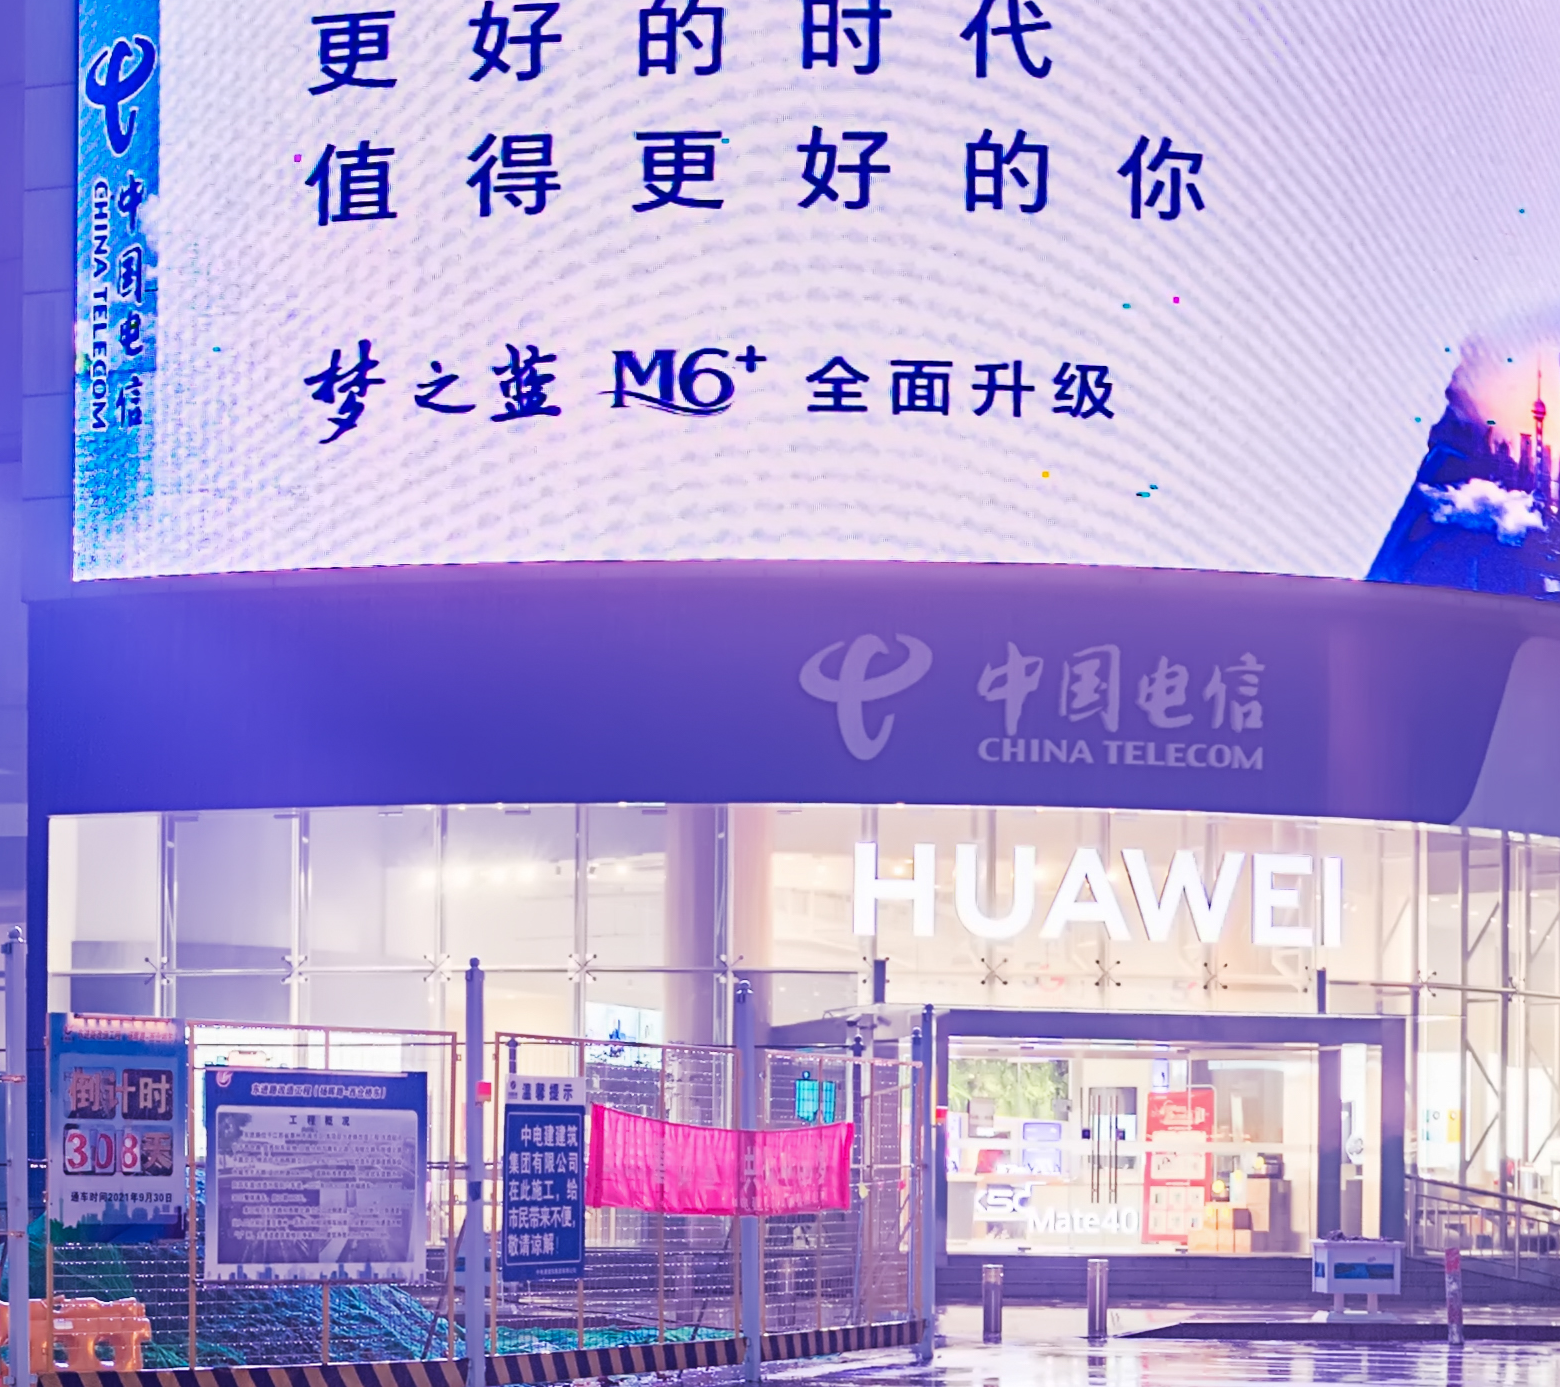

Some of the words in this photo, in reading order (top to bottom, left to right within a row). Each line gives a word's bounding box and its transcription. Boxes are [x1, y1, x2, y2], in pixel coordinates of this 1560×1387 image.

[304, 126, 1207, 228] 值得更好的你
[91, 180, 110, 282] CHINA
[114, 172, 144, 427] 中国电信
[90, 288, 110, 431] TELECOM
[302, 338, 564, 445] 梦之蓝
[805, 356, 1116, 420] 全面升级
[976, 640, 1266, 736] 中国电信
[978, 737, 1095, 765] CHINA
[1103, 739, 1264, 771] TELECOM
[853, 841, 1343, 948] HUAWEI
[69, 1070, 170, 1115] 倒计时
[521, 1082, 574, 1102] 温馨提示
[288, 1114, 350, 1127] 工程概况
[520, 1124, 578, 1147] 中电建建筑
[508, 1151, 579, 1174] 集团有限公司
[70, 1191, 173, 1204] 通车时间2021年9月30日
[508, 1178, 578, 1202] 在此施工，给
[508, 1205, 577, 1229] 市民带来不便，
[1028, 1205, 1140, 1234] Mate40
